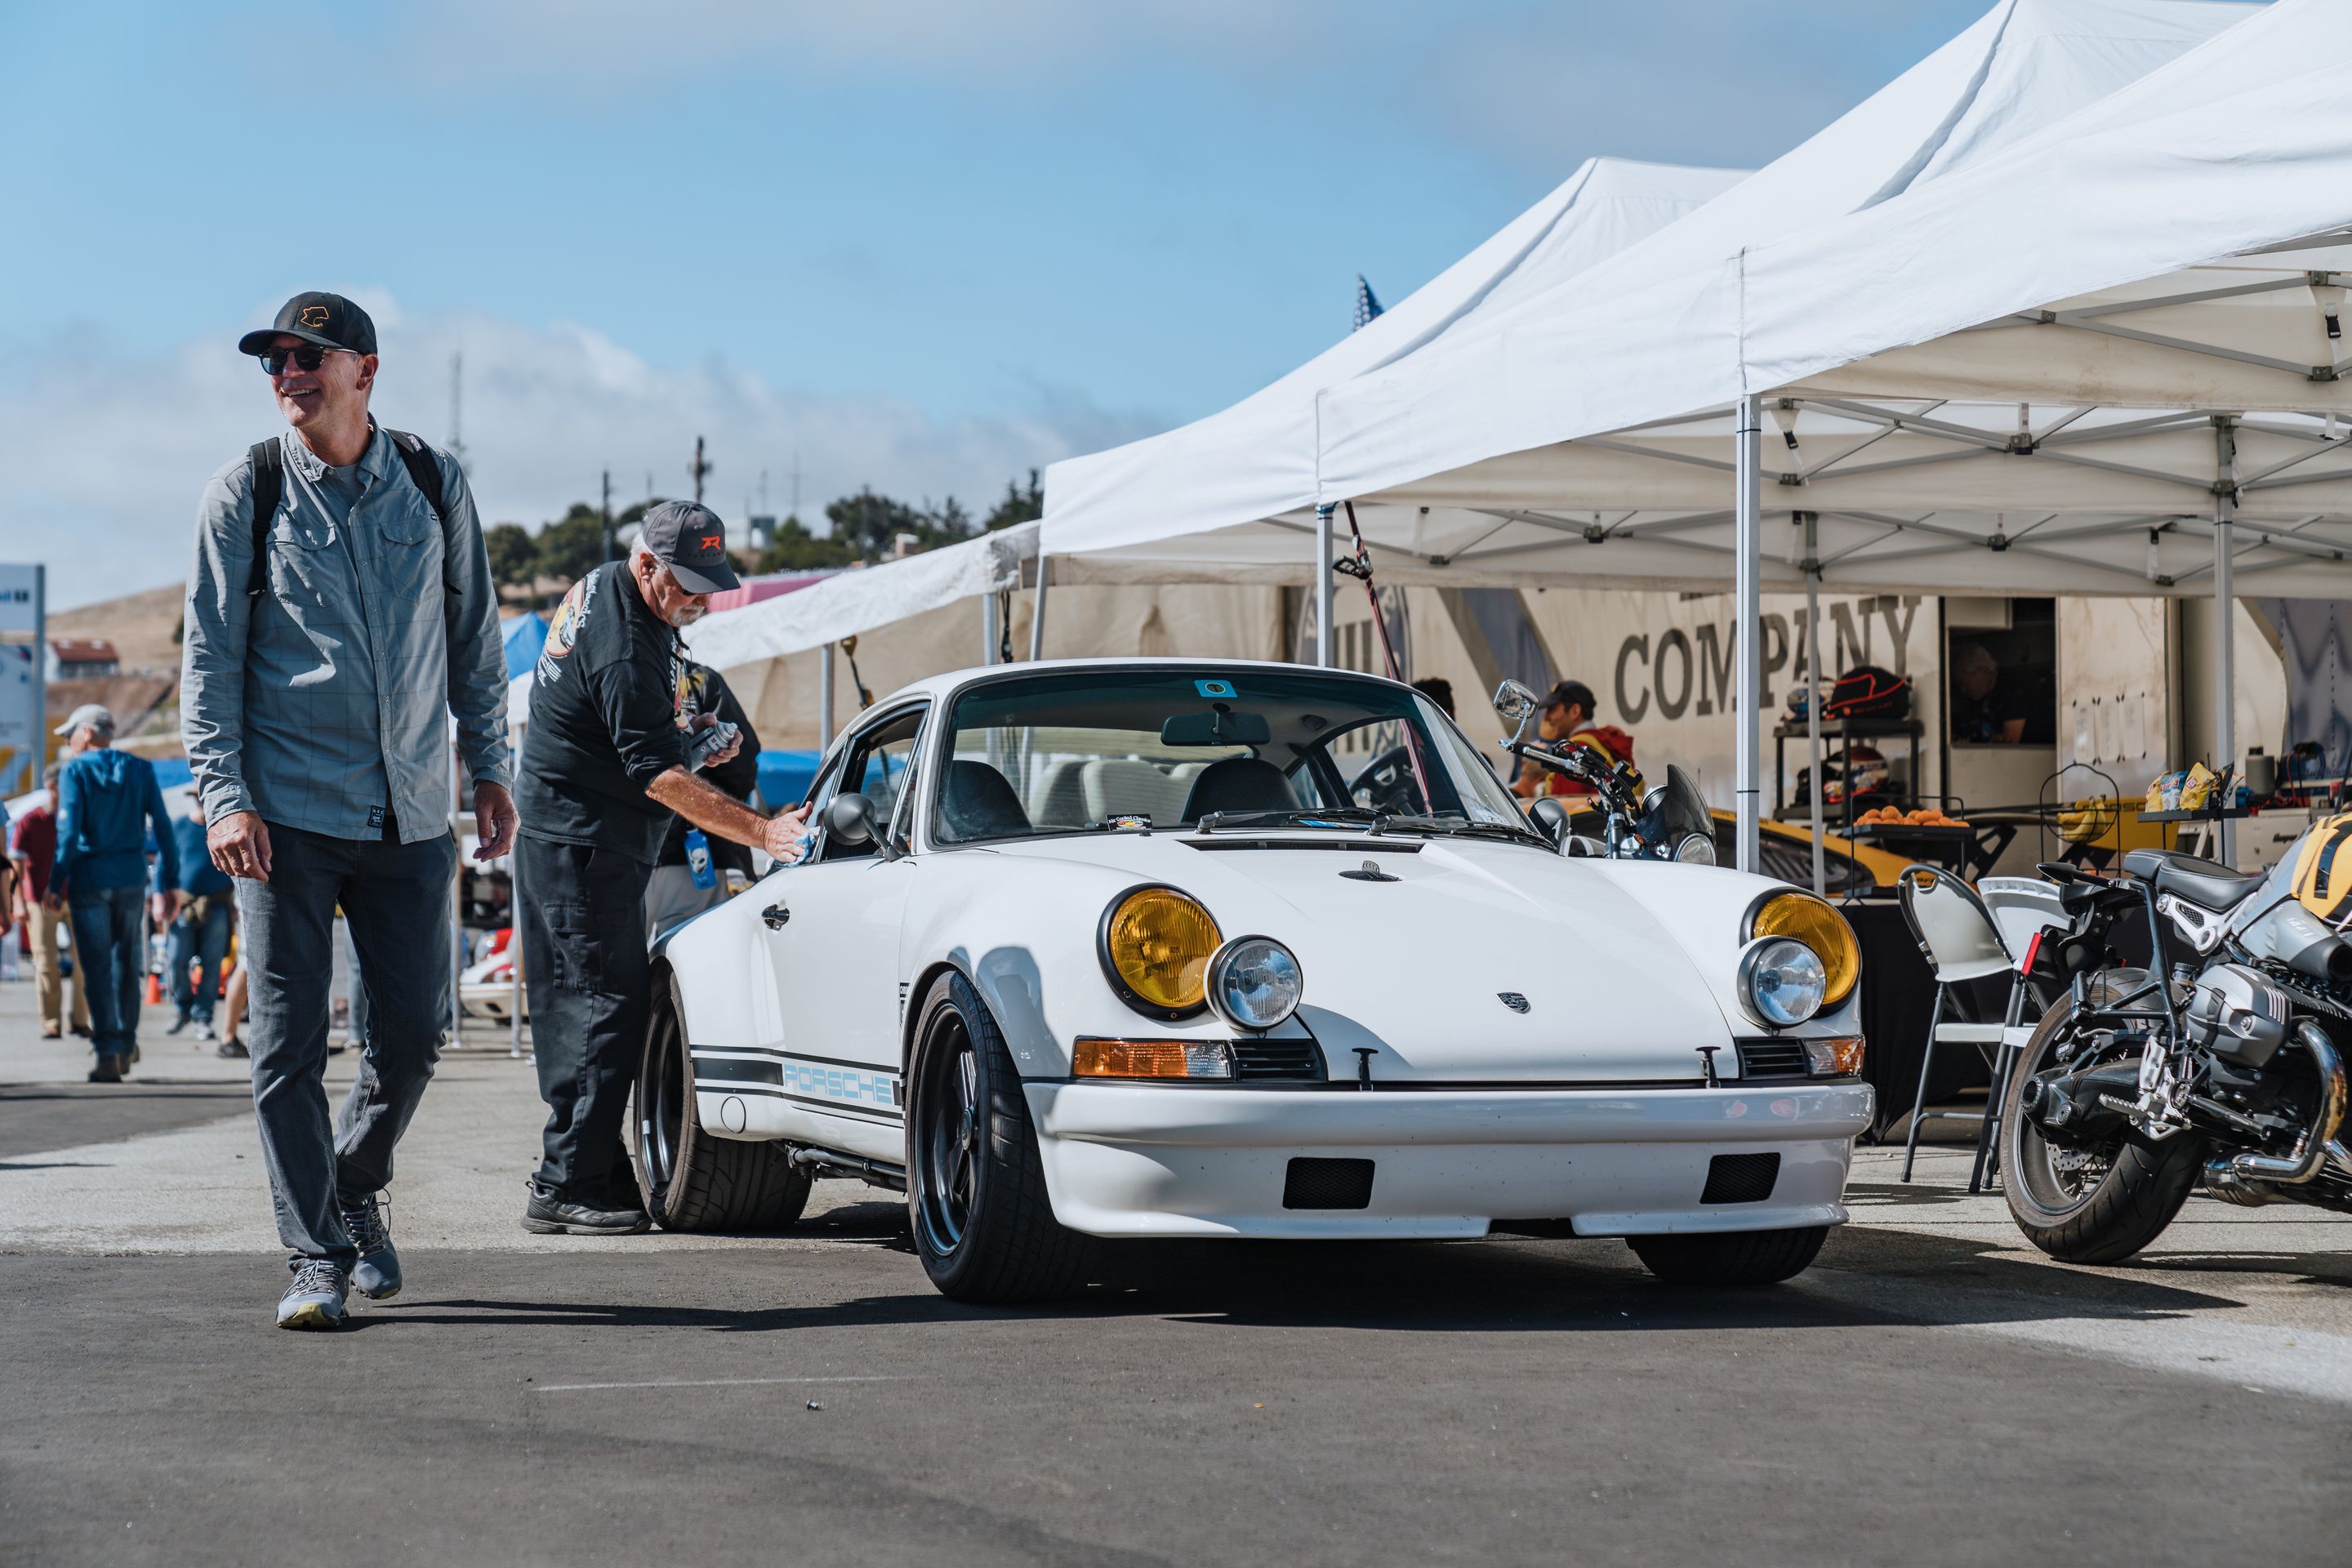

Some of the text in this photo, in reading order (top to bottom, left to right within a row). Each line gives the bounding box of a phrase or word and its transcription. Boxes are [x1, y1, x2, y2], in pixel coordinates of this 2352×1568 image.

[1615, 595, 1922, 724] COMPANY
[2057, 1043, 2070, 1054] BMW
[784, 1063, 892, 1104] PORSCHE
